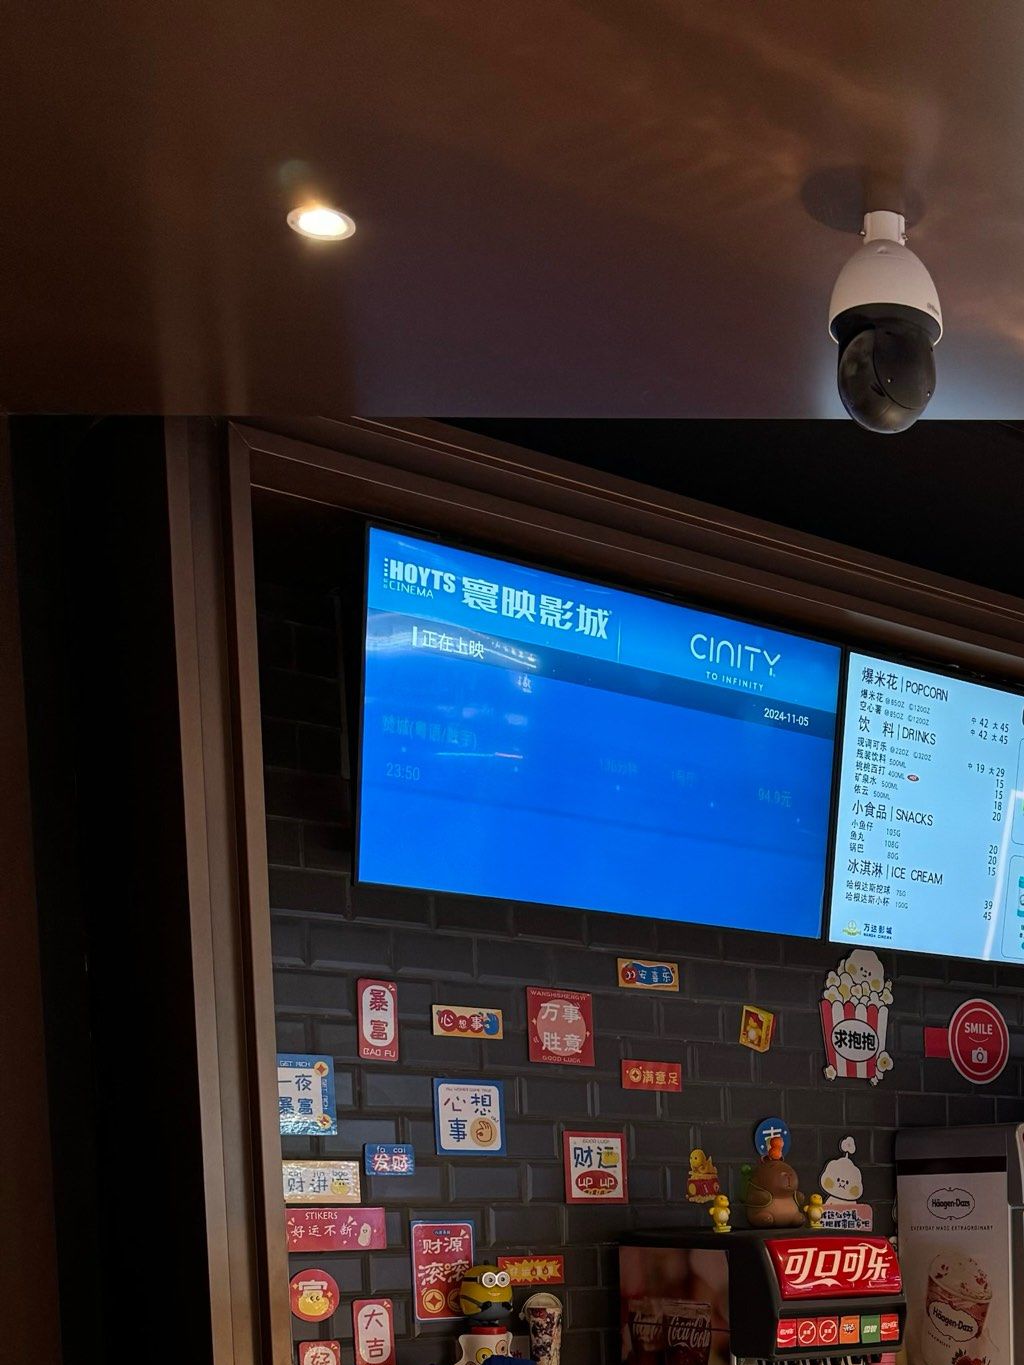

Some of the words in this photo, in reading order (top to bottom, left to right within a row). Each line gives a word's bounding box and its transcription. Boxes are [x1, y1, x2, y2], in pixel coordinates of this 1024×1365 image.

[389, 580, 434, 599] CINEMA
[389, 558, 457, 594] HOYTS
[460, 576, 610, 641] 寰映影城
[421, 628, 485, 660] 正在上映
[690, 633, 781, 677] CINITY
[706, 671, 718, 681] TO
[722, 675, 764, 692] INFINITY
[862, 667, 899, 691] 爆米花
[905, 681, 949, 702] POPCORN
[764, 707, 809, 727] 2024-11-05
[860, 689, 883, 702] 爆米花
[979, 718, 989, 729] 42
[999, 722, 1009, 733] 45
[902, 726, 937, 746] DRINKS
[978, 730, 988, 740] 42
[999, 735, 1008, 745] 45
[857, 736, 887, 751] 现调可乐
[976, 763, 985, 774] 19
[995, 768, 1005, 778] 29
[386, 761, 421, 782] 23:50
[854, 772, 877, 785] 矿泉水
[996, 779, 1004, 789] 15
[995, 790, 1003, 800] 15
[852, 799, 887, 820] 小食品
[895, 808, 934, 827] SNACKS
[992, 811, 1001, 822] 20
[851, 819, 874, 832] 小鱼仔
[989, 845, 998, 855] 20
[850, 830, 865, 842] 鱼丸
[988, 856, 997, 866] 20
[847, 858, 883, 879] 冰淇淋
[891, 867, 906, 880] ICE
[910, 869, 943, 886] CREAM
[987, 866, 996, 877] 15
[983, 900, 993, 910] 39
[982, 911, 992, 921] 45
[369, 988, 389, 1041] 暴富
[439, 1012, 483, 1031] 心想事
[540, 1003, 582, 1024] 万事
[964, 1022, 993, 1035] SMILE
[541, 1031, 582, 1054] 胜意
[833, 1029, 876, 1051] 求抱抱
[363, 1047, 382, 1057] BAO
[384, 1049, 396, 1058] FU
[443, 1093, 492, 1116] 心想
[448, 1118, 468, 1143] 事
[372, 1154, 409, 1172] 发财
[931, 1198, 971, 1210] Häagen-Dazs
[304, 1211, 338, 1220] STIKERS
[291, 1223, 353, 1239] 好运不断
[419, 1236, 464, 1254] 财源
[784, 1242, 894, 1284] 可口可乐
[932, 1306, 974, 1334] Häagen-Dazs
[363, 1309, 385, 1359] 大吉
